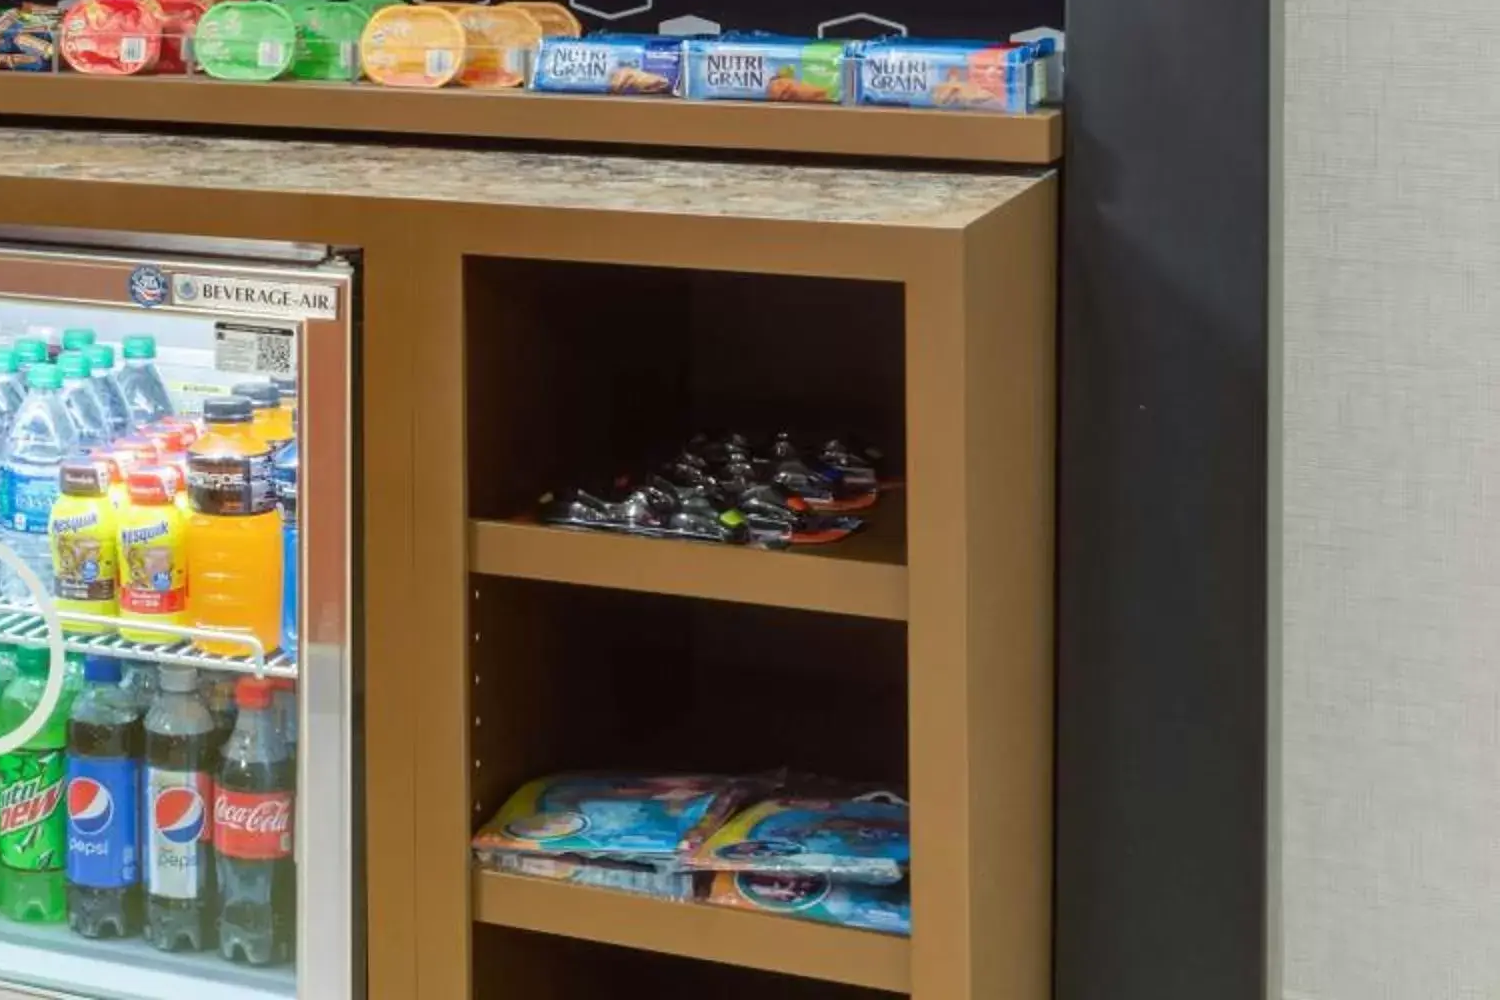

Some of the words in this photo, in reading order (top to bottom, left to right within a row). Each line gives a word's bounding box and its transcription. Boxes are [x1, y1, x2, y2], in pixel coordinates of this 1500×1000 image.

[707, 55, 763, 71] NUTRI
[868, 58, 928, 73] NUTRI
[707, 71, 763, 88] GRAIN
[870, 74, 928, 91] GRAIN
